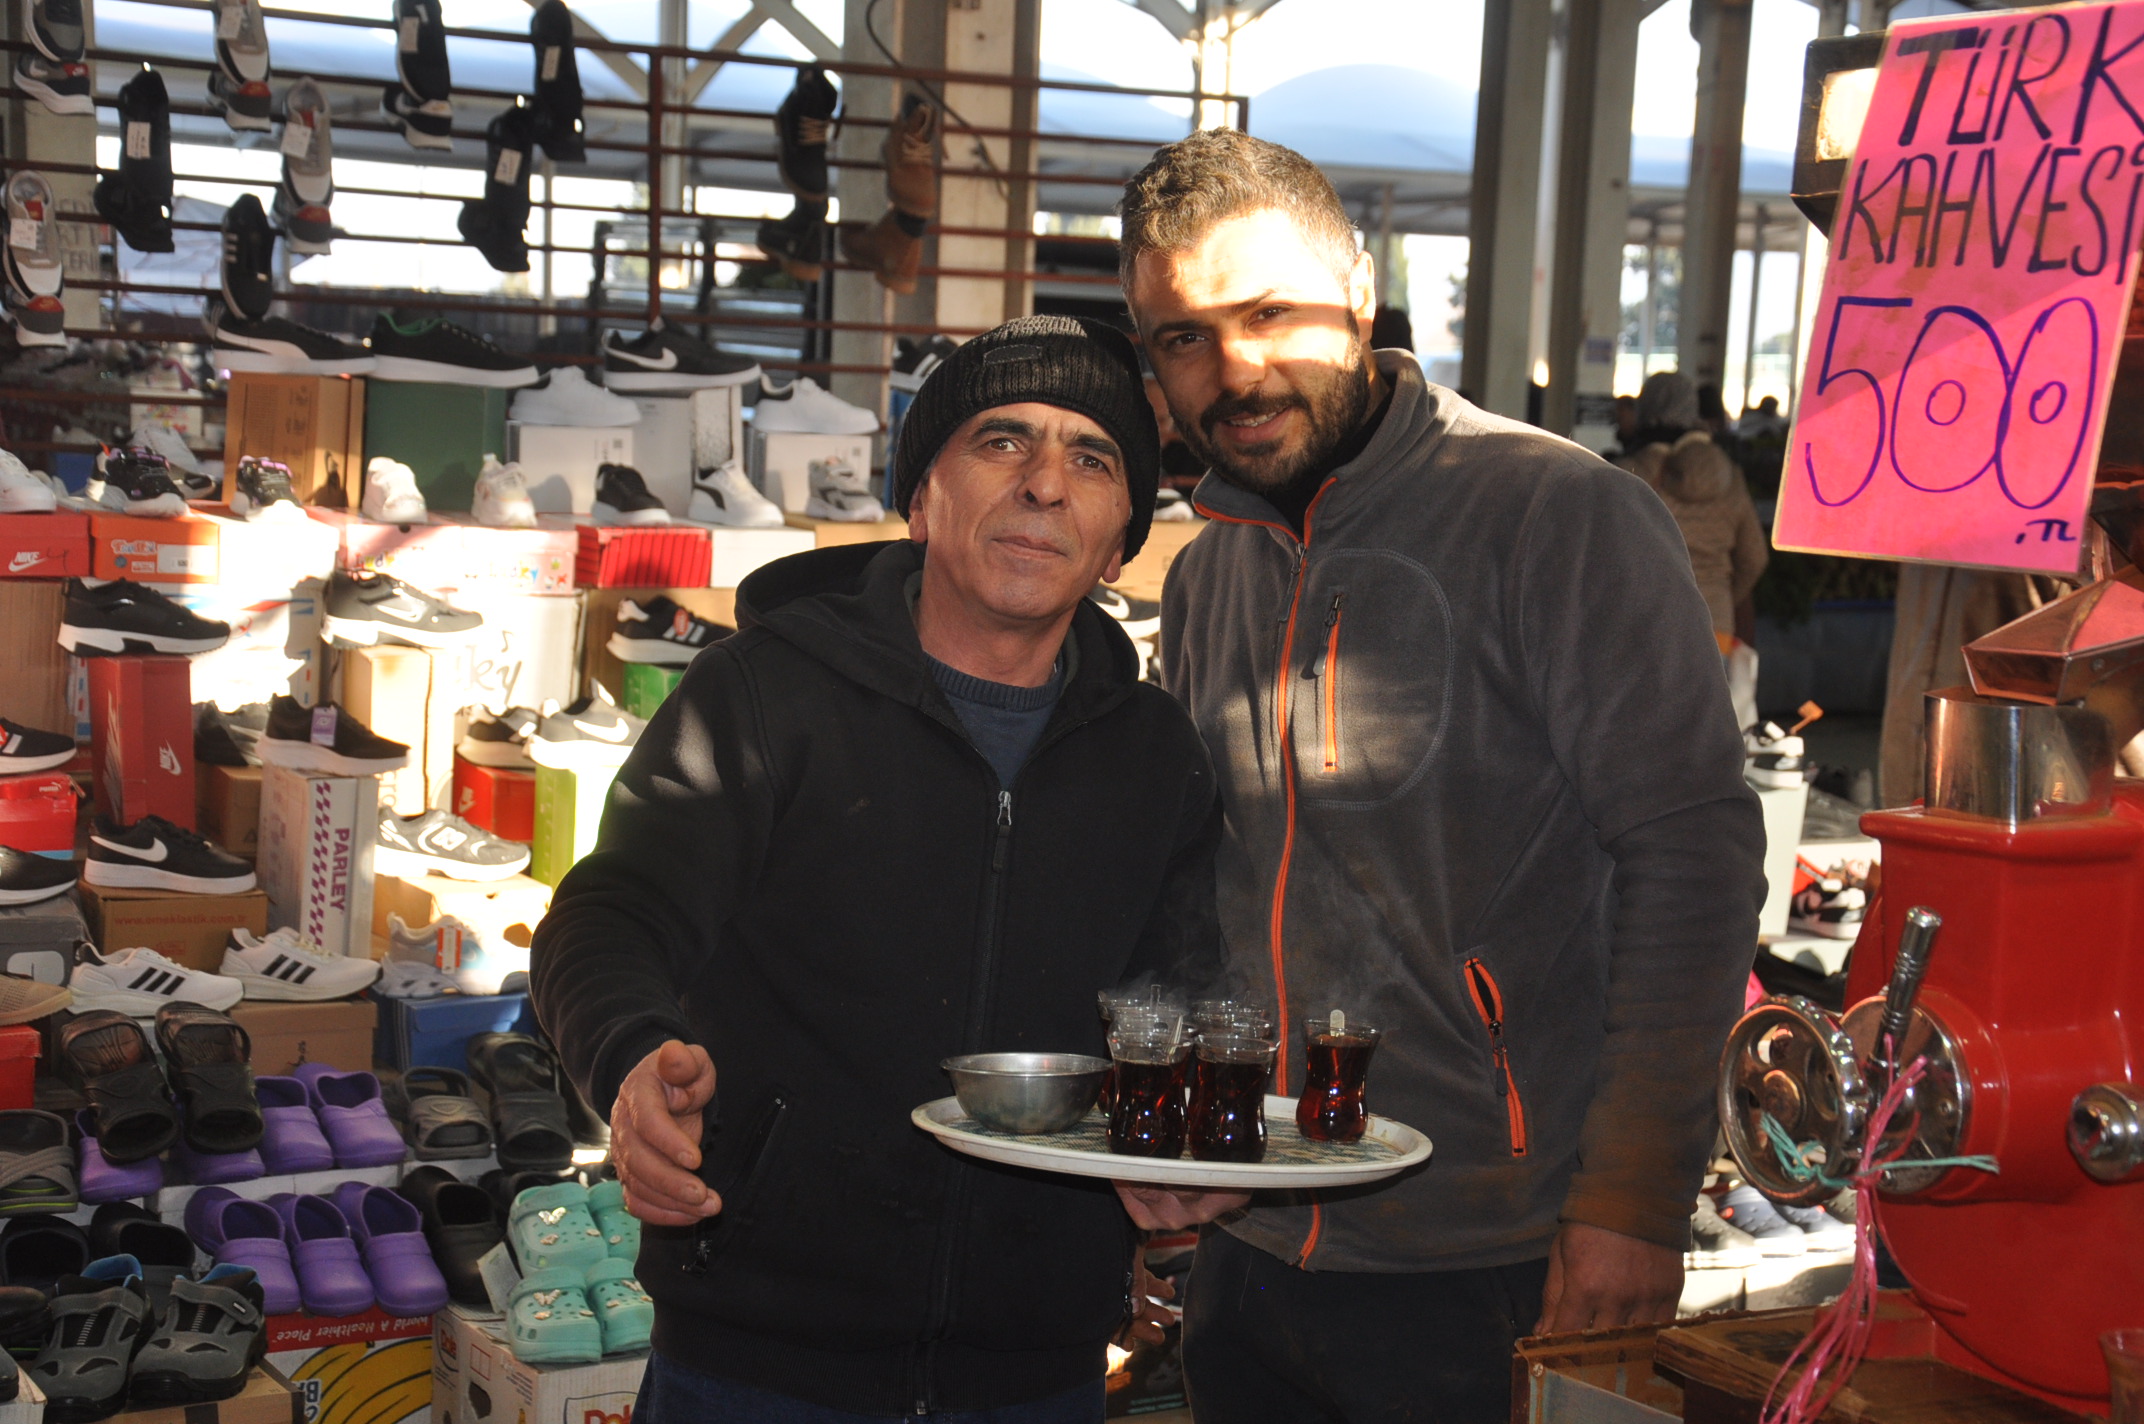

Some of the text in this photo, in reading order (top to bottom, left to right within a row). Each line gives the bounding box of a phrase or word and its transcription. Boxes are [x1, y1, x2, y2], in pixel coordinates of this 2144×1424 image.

[1897, 5, 2144, 146] TÜRK
[1805, 295, 2100, 510] 500
[14, 551, 40, 563] NIKE
[329, 827, 350, 911] PARLEY
[276, 1328, 312, 1343] Place
[315, 1321, 375, 1338] Healthier
